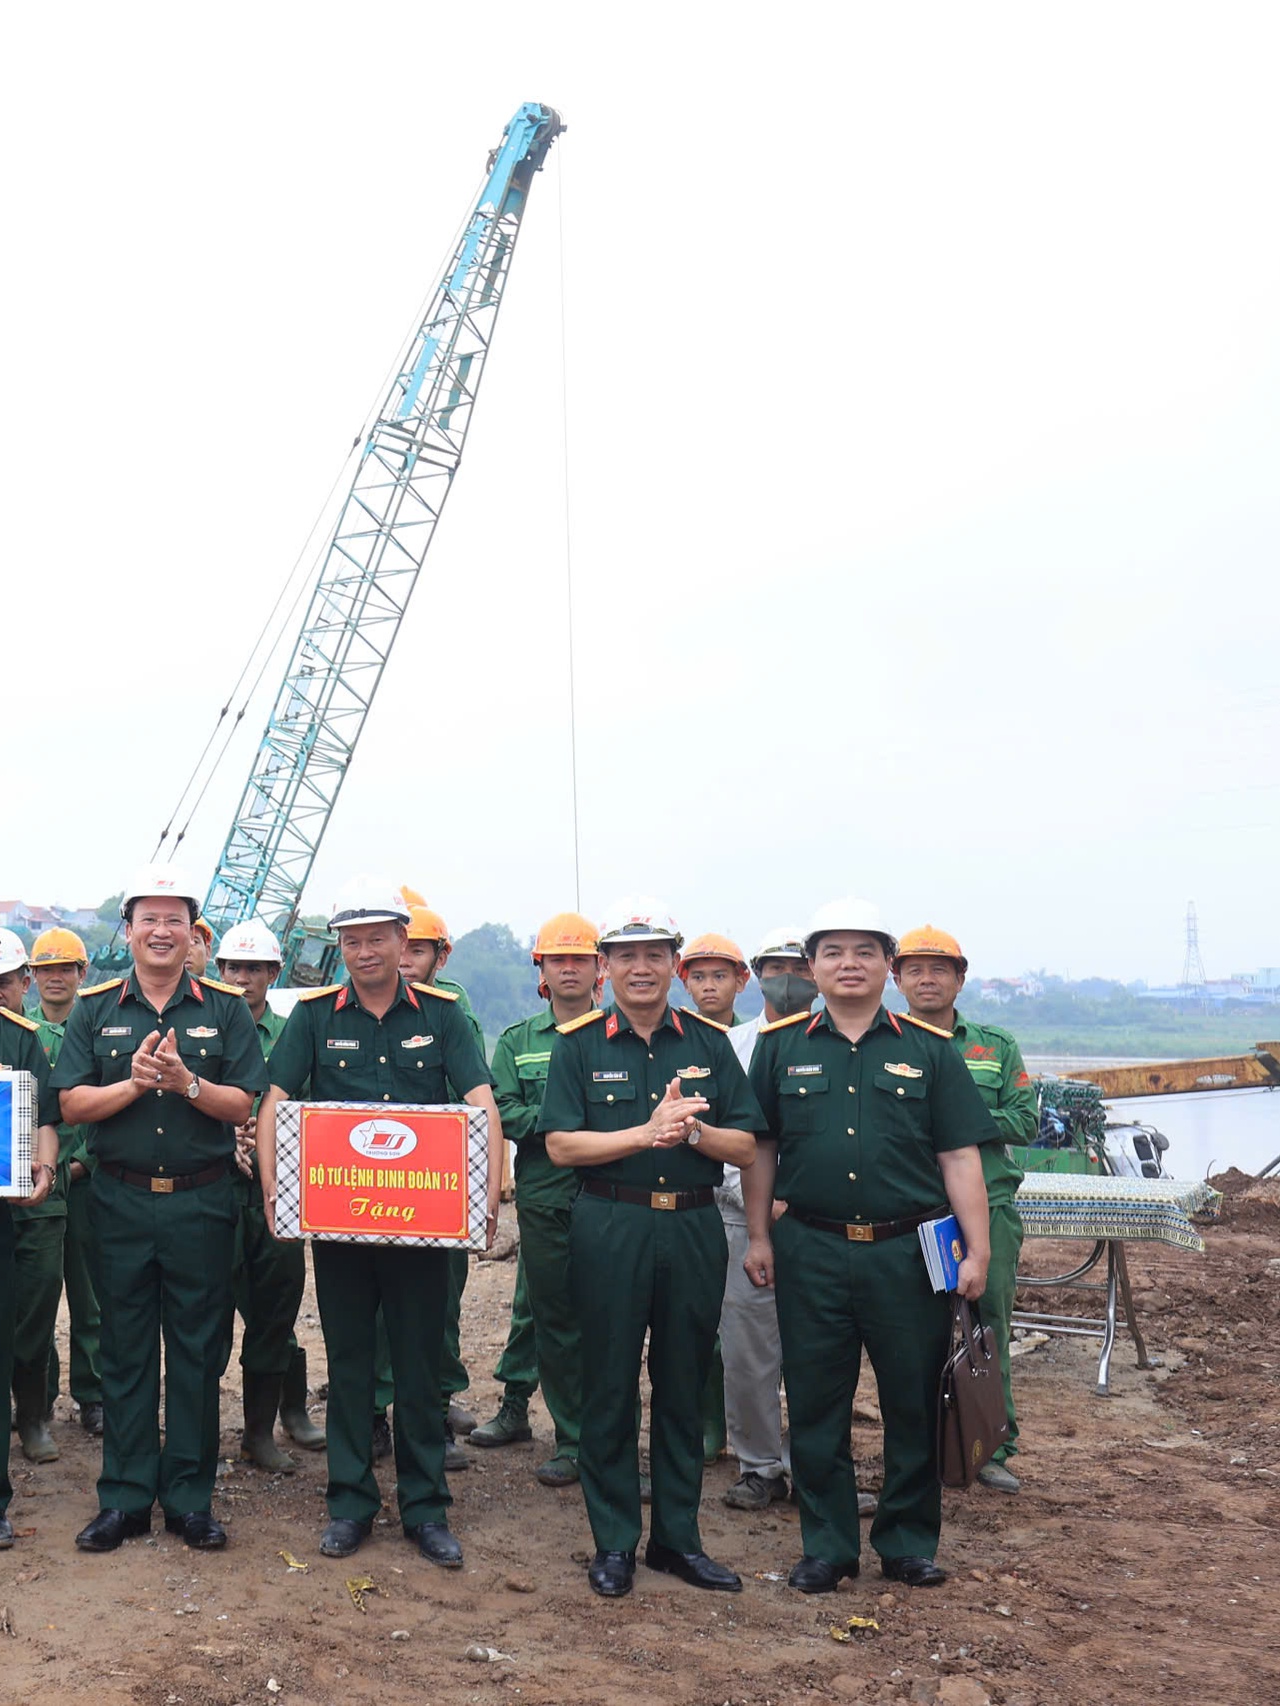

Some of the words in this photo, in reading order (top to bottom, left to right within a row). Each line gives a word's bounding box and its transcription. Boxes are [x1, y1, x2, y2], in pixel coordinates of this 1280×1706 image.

[309, 1163, 325, 1190] BỘ
[327, 1166, 343, 1186] TƯ
[344, 1164, 374, 1191] LỆNH
[377, 1169, 405, 1188] BINH
[408, 1167, 440, 1190] ĐOÀN
[443, 1171, 458, 1191] 12
[349, 1197, 416, 1222] Tặng
